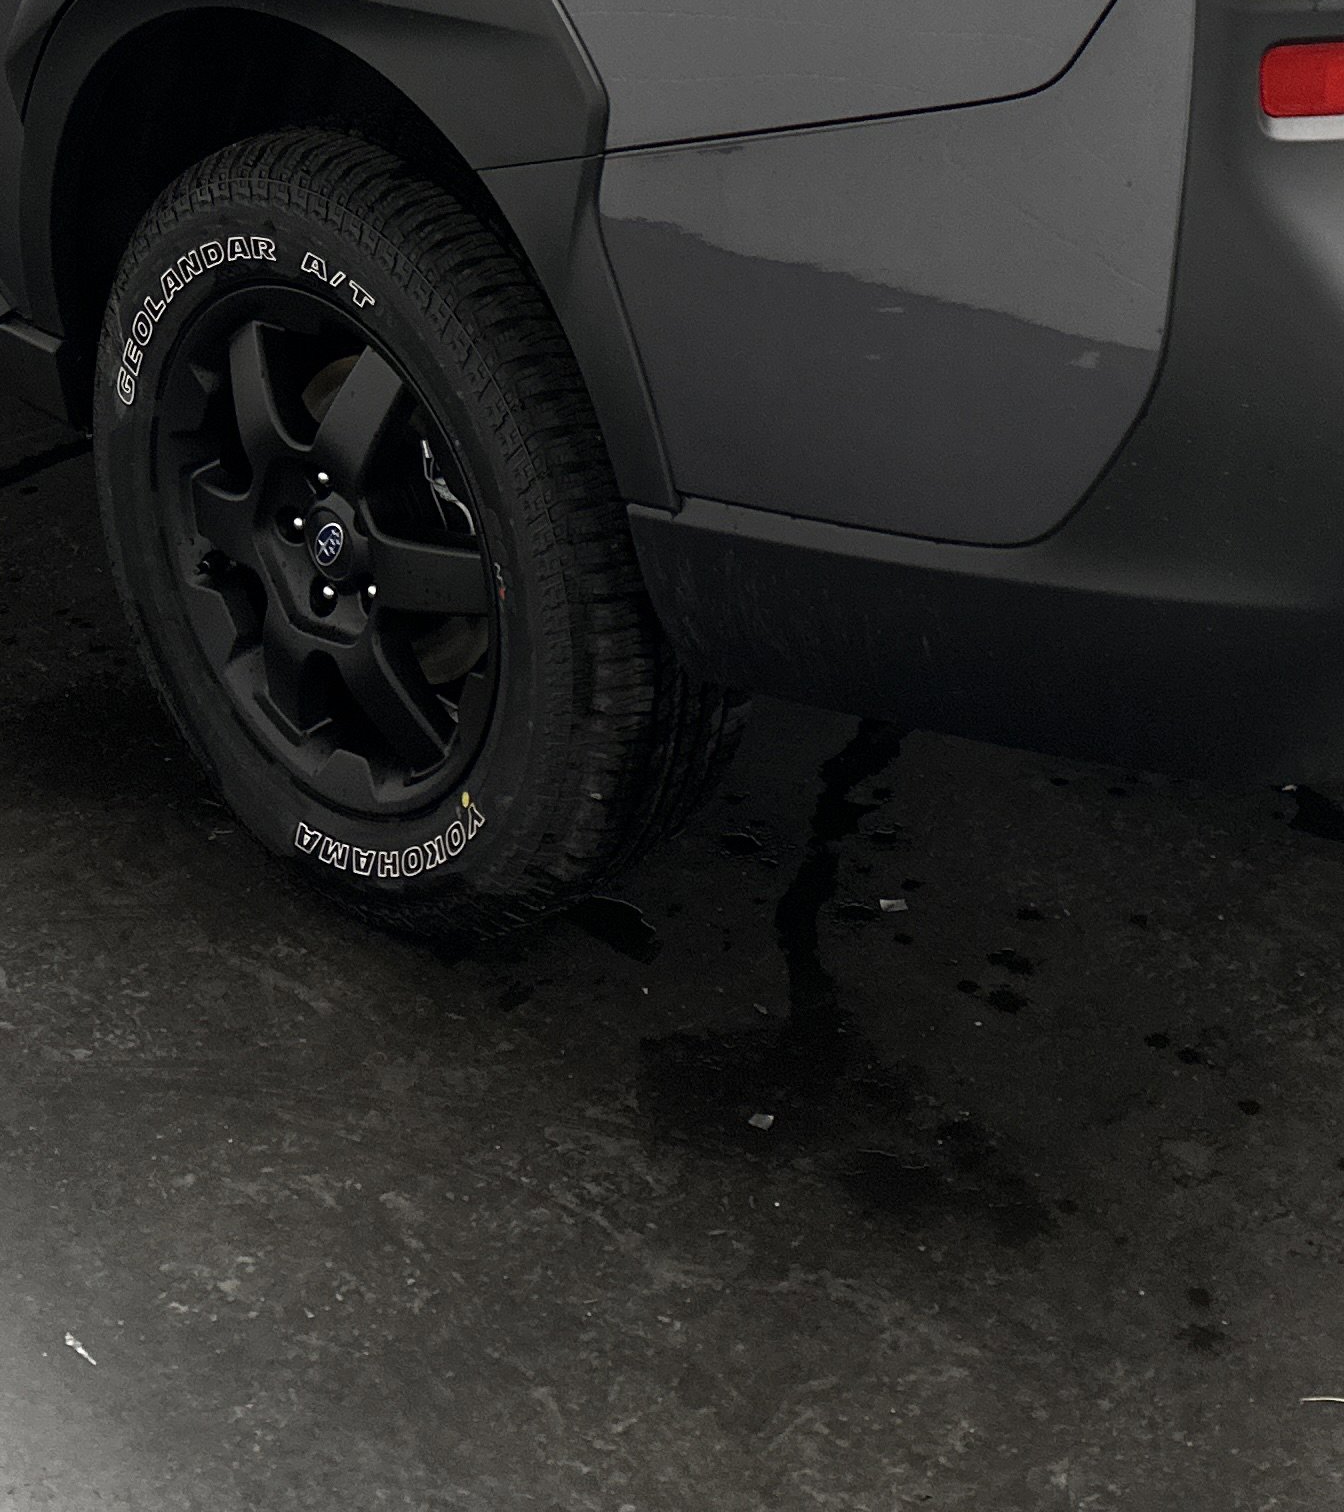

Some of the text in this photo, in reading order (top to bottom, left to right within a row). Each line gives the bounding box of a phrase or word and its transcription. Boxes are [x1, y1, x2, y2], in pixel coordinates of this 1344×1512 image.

[117, 236, 375, 405] GEOLANDAR A/T
[295, 803, 485, 877] YOKOHAMA
